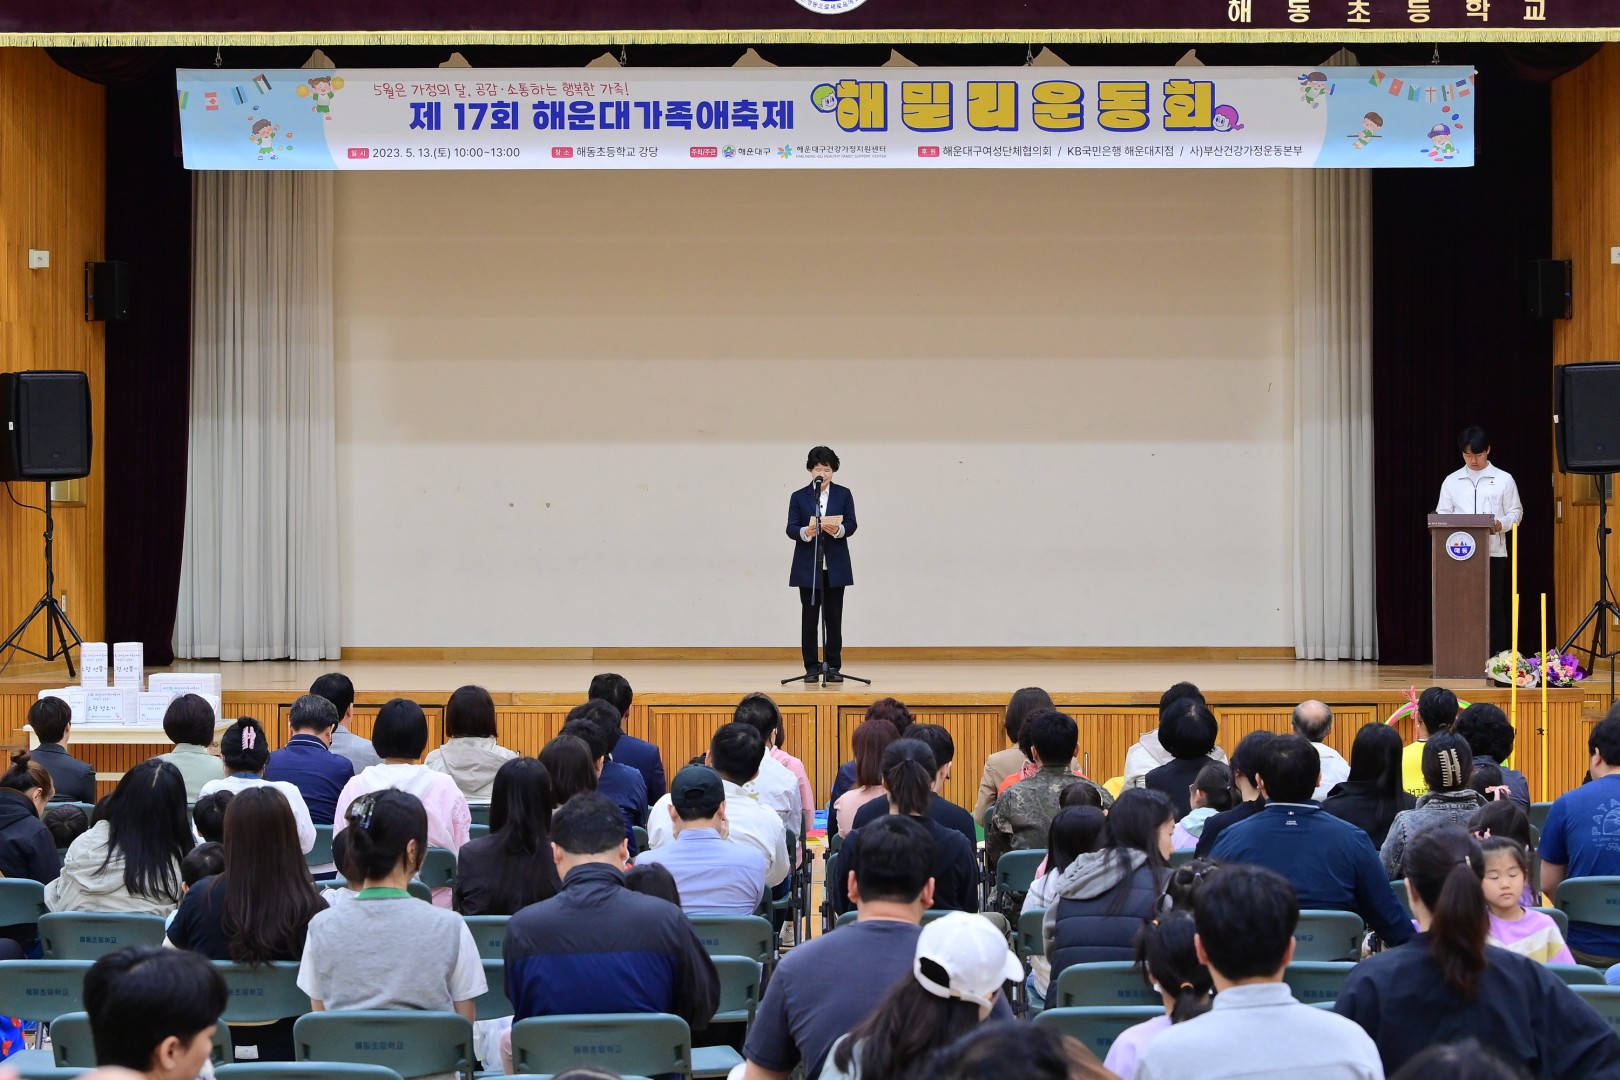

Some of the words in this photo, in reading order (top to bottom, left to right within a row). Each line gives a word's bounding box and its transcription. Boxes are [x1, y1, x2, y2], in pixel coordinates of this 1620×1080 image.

[374, 83, 407, 99] 5월은
[411, 83, 450, 97] 가정의
[562, 82, 595, 96] 행복한
[600, 82, 630, 96] 가족!
[409, 101, 441, 131] 제
[453, 101, 519, 131] 17회
[532, 100, 795, 131] 해운대가족애축제
[373, 148, 403, 157] 2023.
[406, 148, 415, 157] 5.
[418, 148, 451, 159] 13.(토)
[454, 148, 520, 157] 10:00~13:00
[576, 147, 636, 158] 해동초등학교
[639, 147, 659, 158] 강당
[739, 147, 771, 156] 해운대구
[797, 146, 886, 154] 해운대구건강가정지원센터
[942, 146, 1052, 157] 해운대구여성단체협의회
[1067, 146, 1122, 157] KB국민은행
[1125, 146, 1174, 157] 해운대지점
[1190, 146, 1303, 158] 사)부산건강가정운동본부
